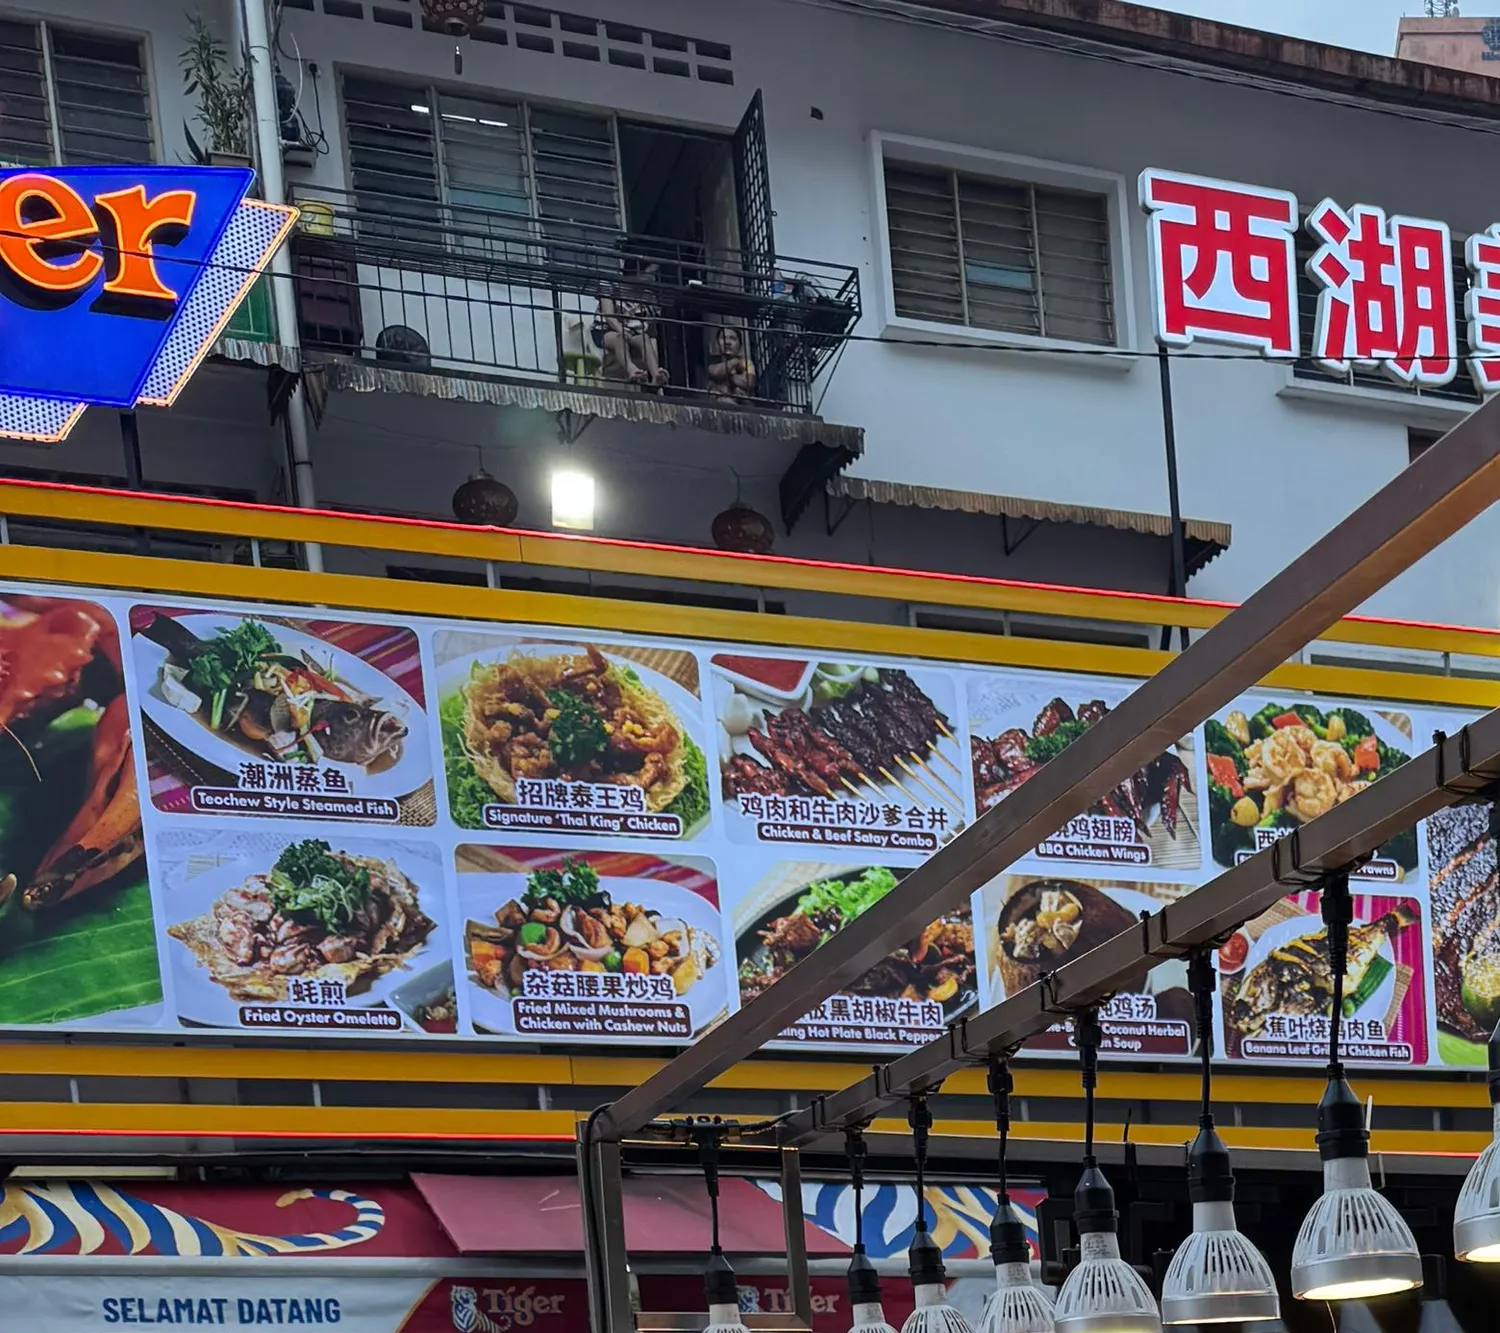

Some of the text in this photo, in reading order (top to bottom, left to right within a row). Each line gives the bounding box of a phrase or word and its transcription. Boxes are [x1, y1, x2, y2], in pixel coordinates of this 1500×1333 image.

[0, 172, 197, 305] er
[237, 763, 350, 795] 潮洲蒸鱼
[198, 791, 394, 816] Teochew Style Steamed Fish
[518, 780, 644, 812] 招牌泰王鸡
[488, 809, 553, 826] Signature
[627, 816, 678, 832] Chicken
[761, 826, 933, 848] Chicken & Beef Satay Combo
[1039, 842, 1146, 863] BBQ Chicken Wings
[1356, 865, 1394, 876] rawns
[291, 979, 345, 1006] 蚝煎
[526, 971, 674, 999] 杂菇腰果炒鸡
[245, 1009, 397, 1027] Fried Oyster Omelette
[518, 1003, 684, 1018] Fried Mixed Mushrooms &
[805, 998, 941, 1027] 板黑胡椒牛肉
[520, 1017, 687, 1033] Chicken with Cashew Nuts
[807, 1027, 830, 1038] Hot
[832, 1028, 862, 1040] Plate
[864, 1028, 895, 1041] Black
[1102, 1023, 1185, 1037] Coconut Herbal
[1113, 1038, 1141, 1051] Soup
[1246, 1043, 1286, 1055] Banana
[1288, 1044, 1310, 1056] Leaf
[1349, 1046, 1388, 1058] Chicken
[1390, 1047, 1409, 1059] Fish
[482, 1286, 565, 1326] Tiger
[764, 1285, 840, 1313] Tier
[103, 1297, 341, 1325] SELAMAT DATANG
